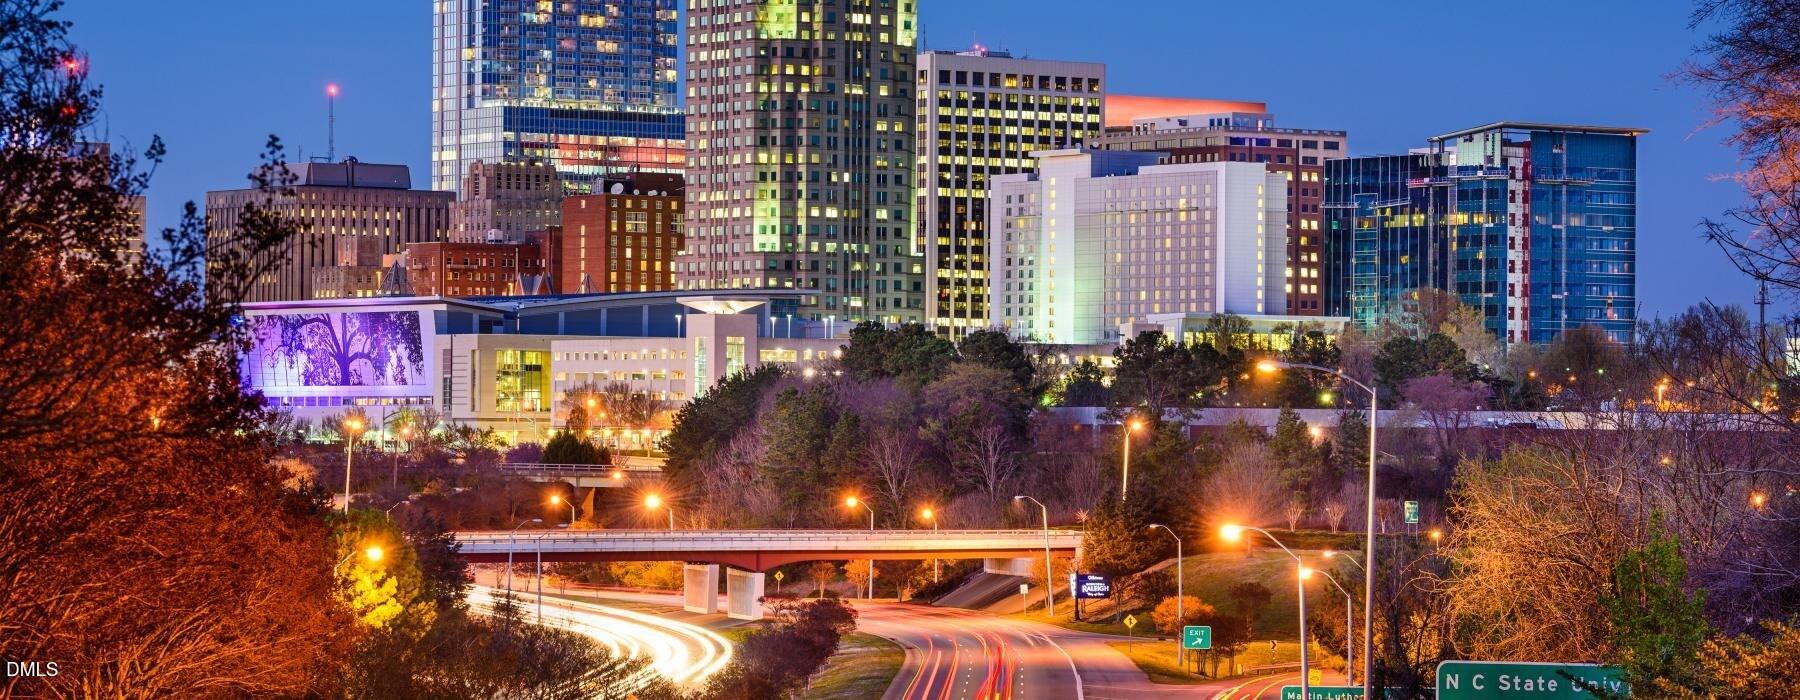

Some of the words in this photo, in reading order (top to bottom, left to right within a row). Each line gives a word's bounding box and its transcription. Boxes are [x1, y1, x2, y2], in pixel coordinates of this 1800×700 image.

[1446, 673, 1459, 690] N
[1472, 674, 1485, 690] C
[1498, 674, 1558, 692] State
[1287, 692, 1323, 700] Matin
